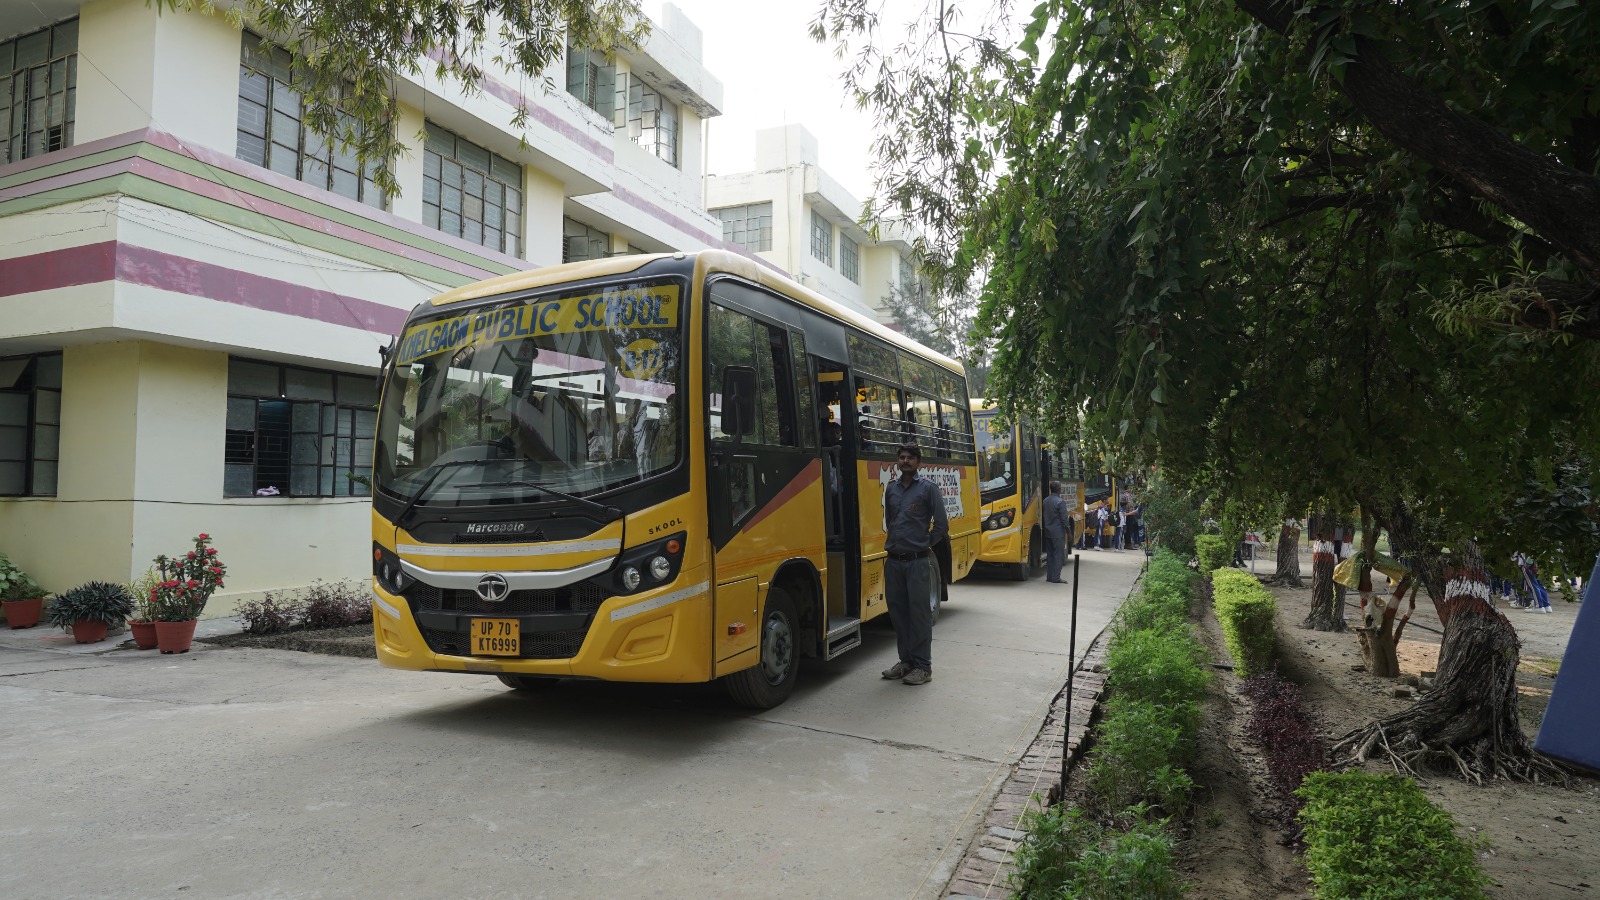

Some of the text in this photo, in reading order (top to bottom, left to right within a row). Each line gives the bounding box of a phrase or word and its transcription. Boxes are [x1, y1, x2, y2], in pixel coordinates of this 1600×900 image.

[472, 303, 561, 340] PUBLIC
[574, 294, 668, 328] SCHOOL
[625, 348, 661, 371] B-17
[466, 522, 526, 533] Marcopolo
[648, 517, 683, 535] SKOOL
[481, 621, 511, 635] UP 70
[479, 637, 517, 652] KT6999
